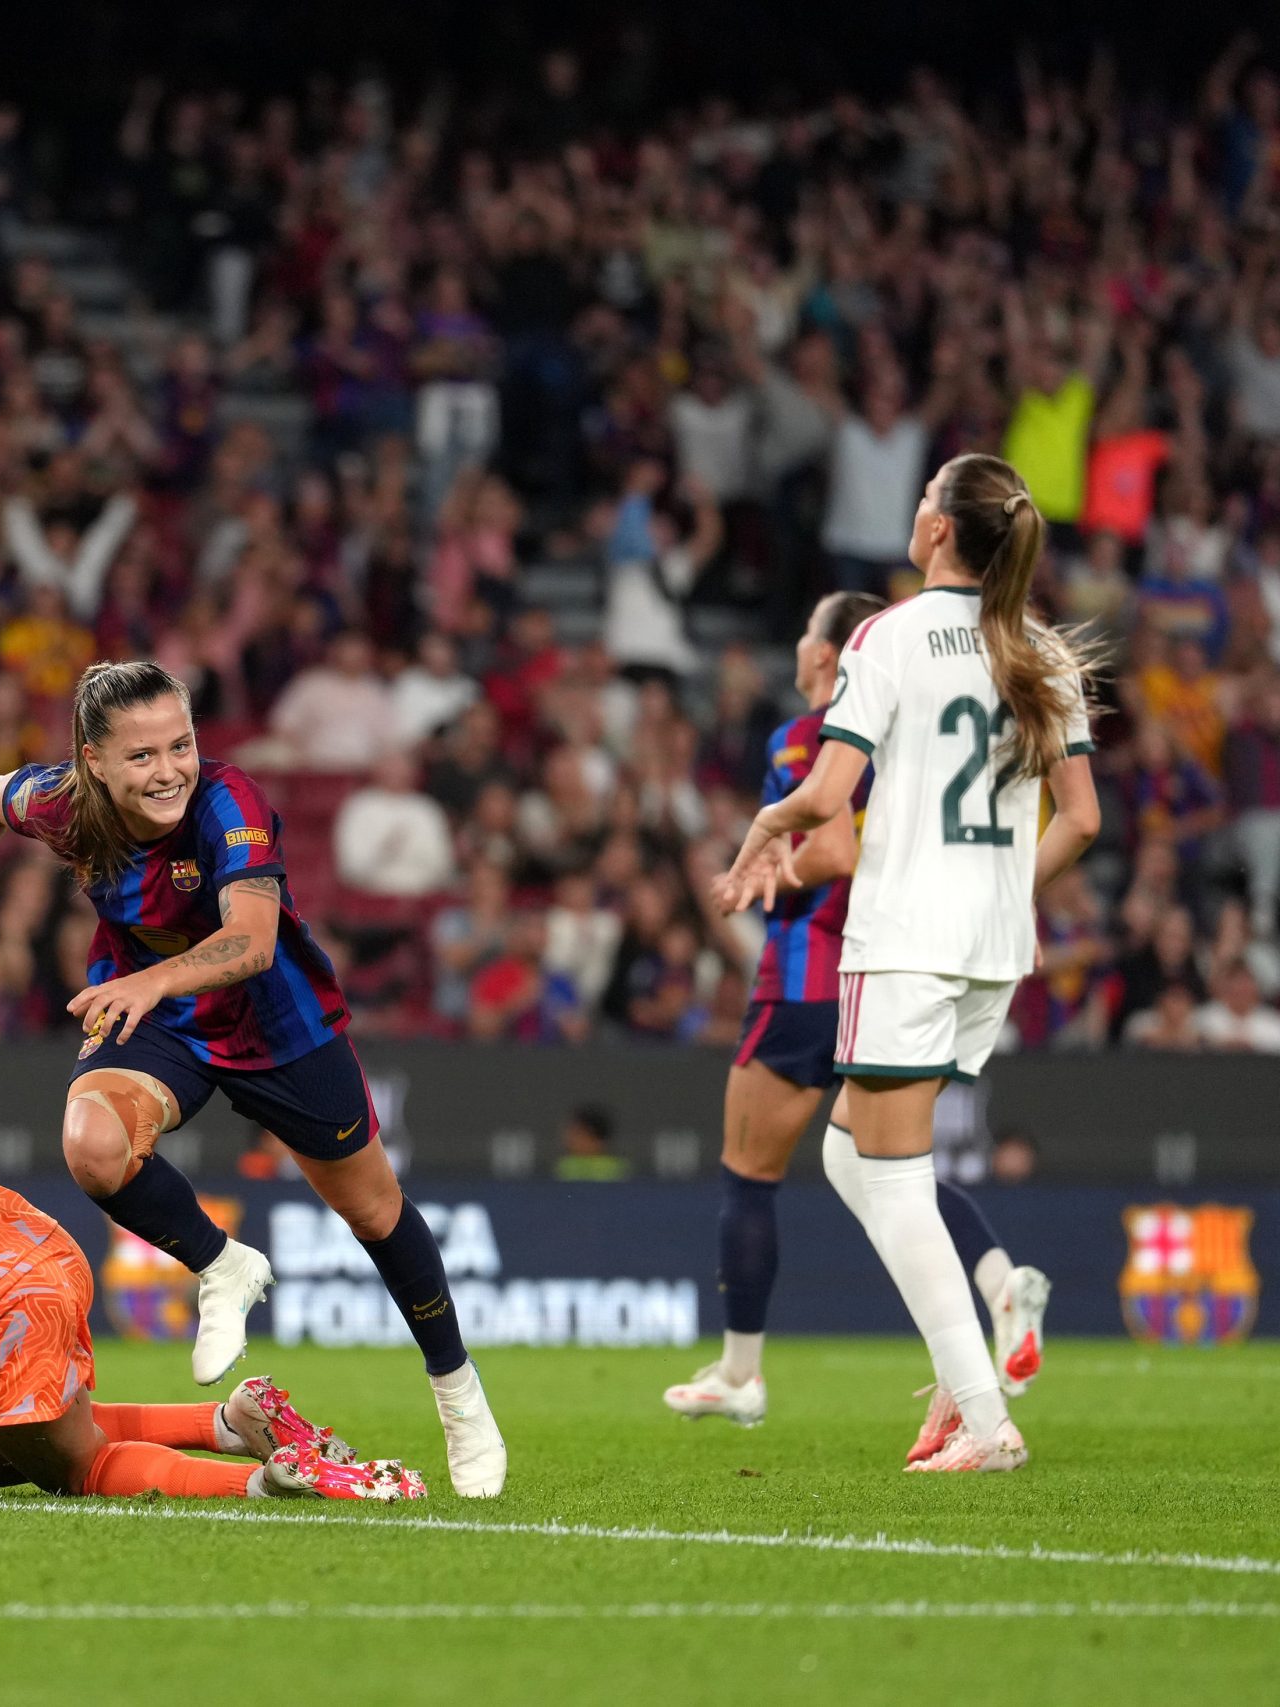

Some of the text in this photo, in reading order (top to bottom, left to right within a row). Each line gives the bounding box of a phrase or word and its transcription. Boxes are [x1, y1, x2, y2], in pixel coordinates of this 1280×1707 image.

[938, 695, 1014, 847] 22
[224, 829, 269, 846] BIMBO
[272, 1278, 701, 1348] FOUDATION
